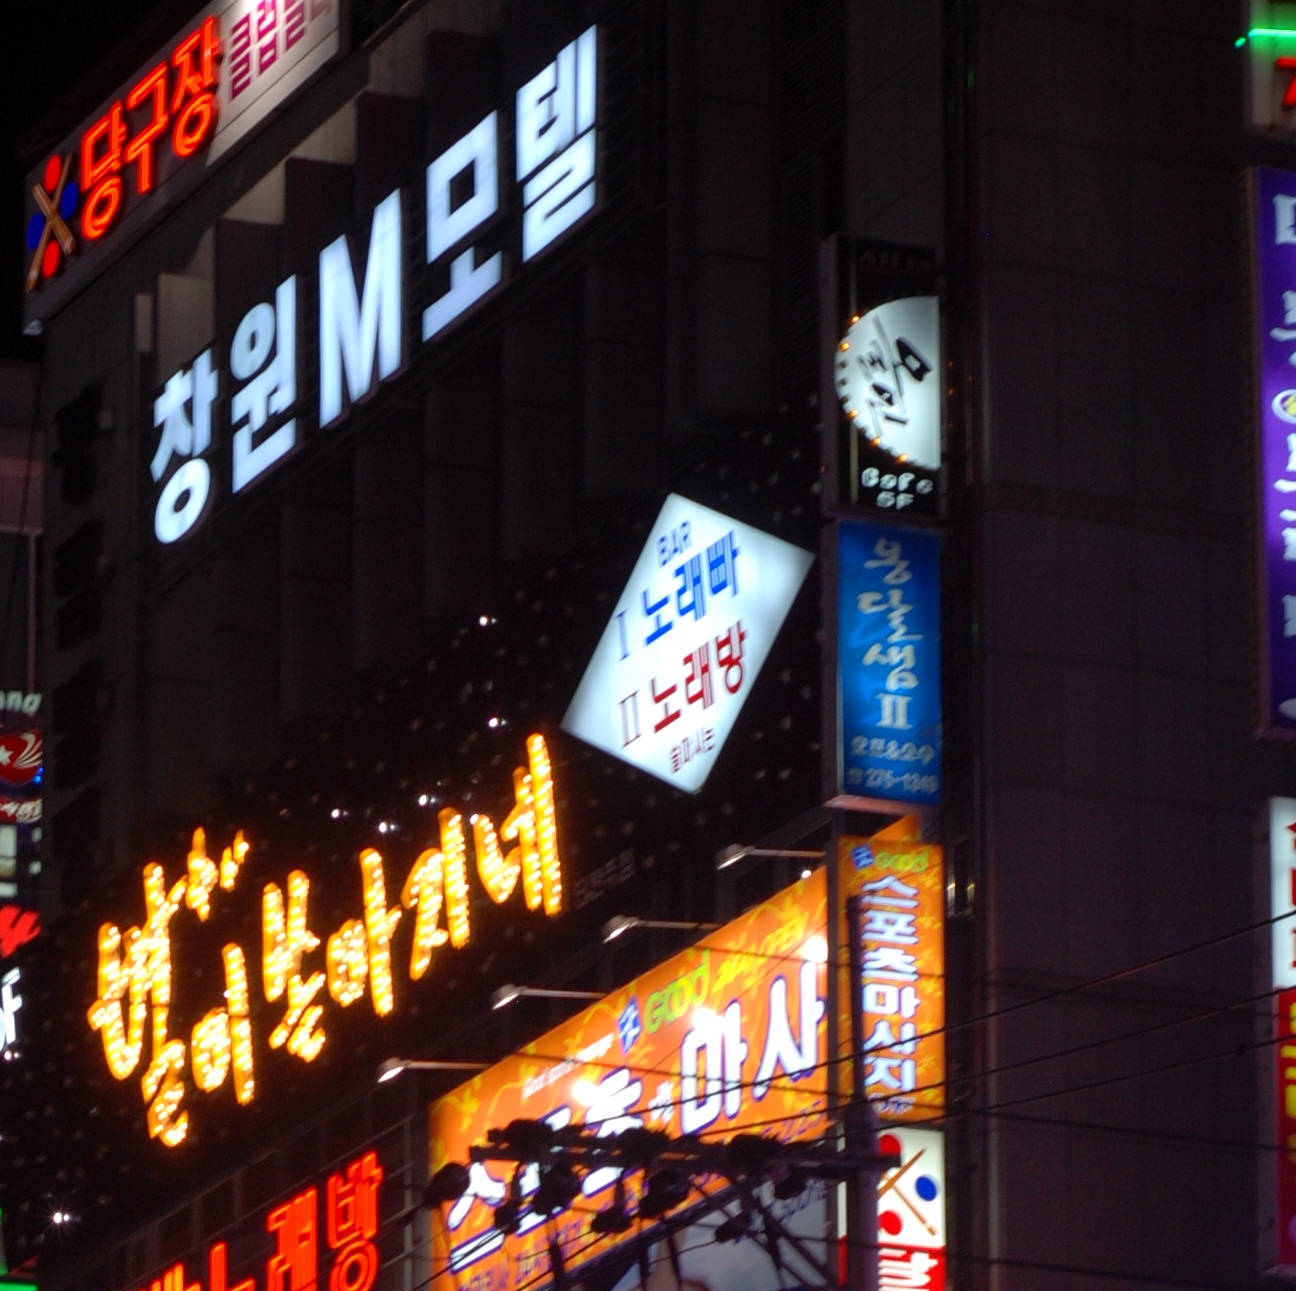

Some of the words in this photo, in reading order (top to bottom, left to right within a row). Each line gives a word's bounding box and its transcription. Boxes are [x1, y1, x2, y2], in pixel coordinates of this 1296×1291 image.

[80, 14, 223, 241] 당구장
[657, 520, 694, 569] BAR
[650, 620, 749, 733] 노래방
[861, 875, 922, 1093] 스포츠마사지
